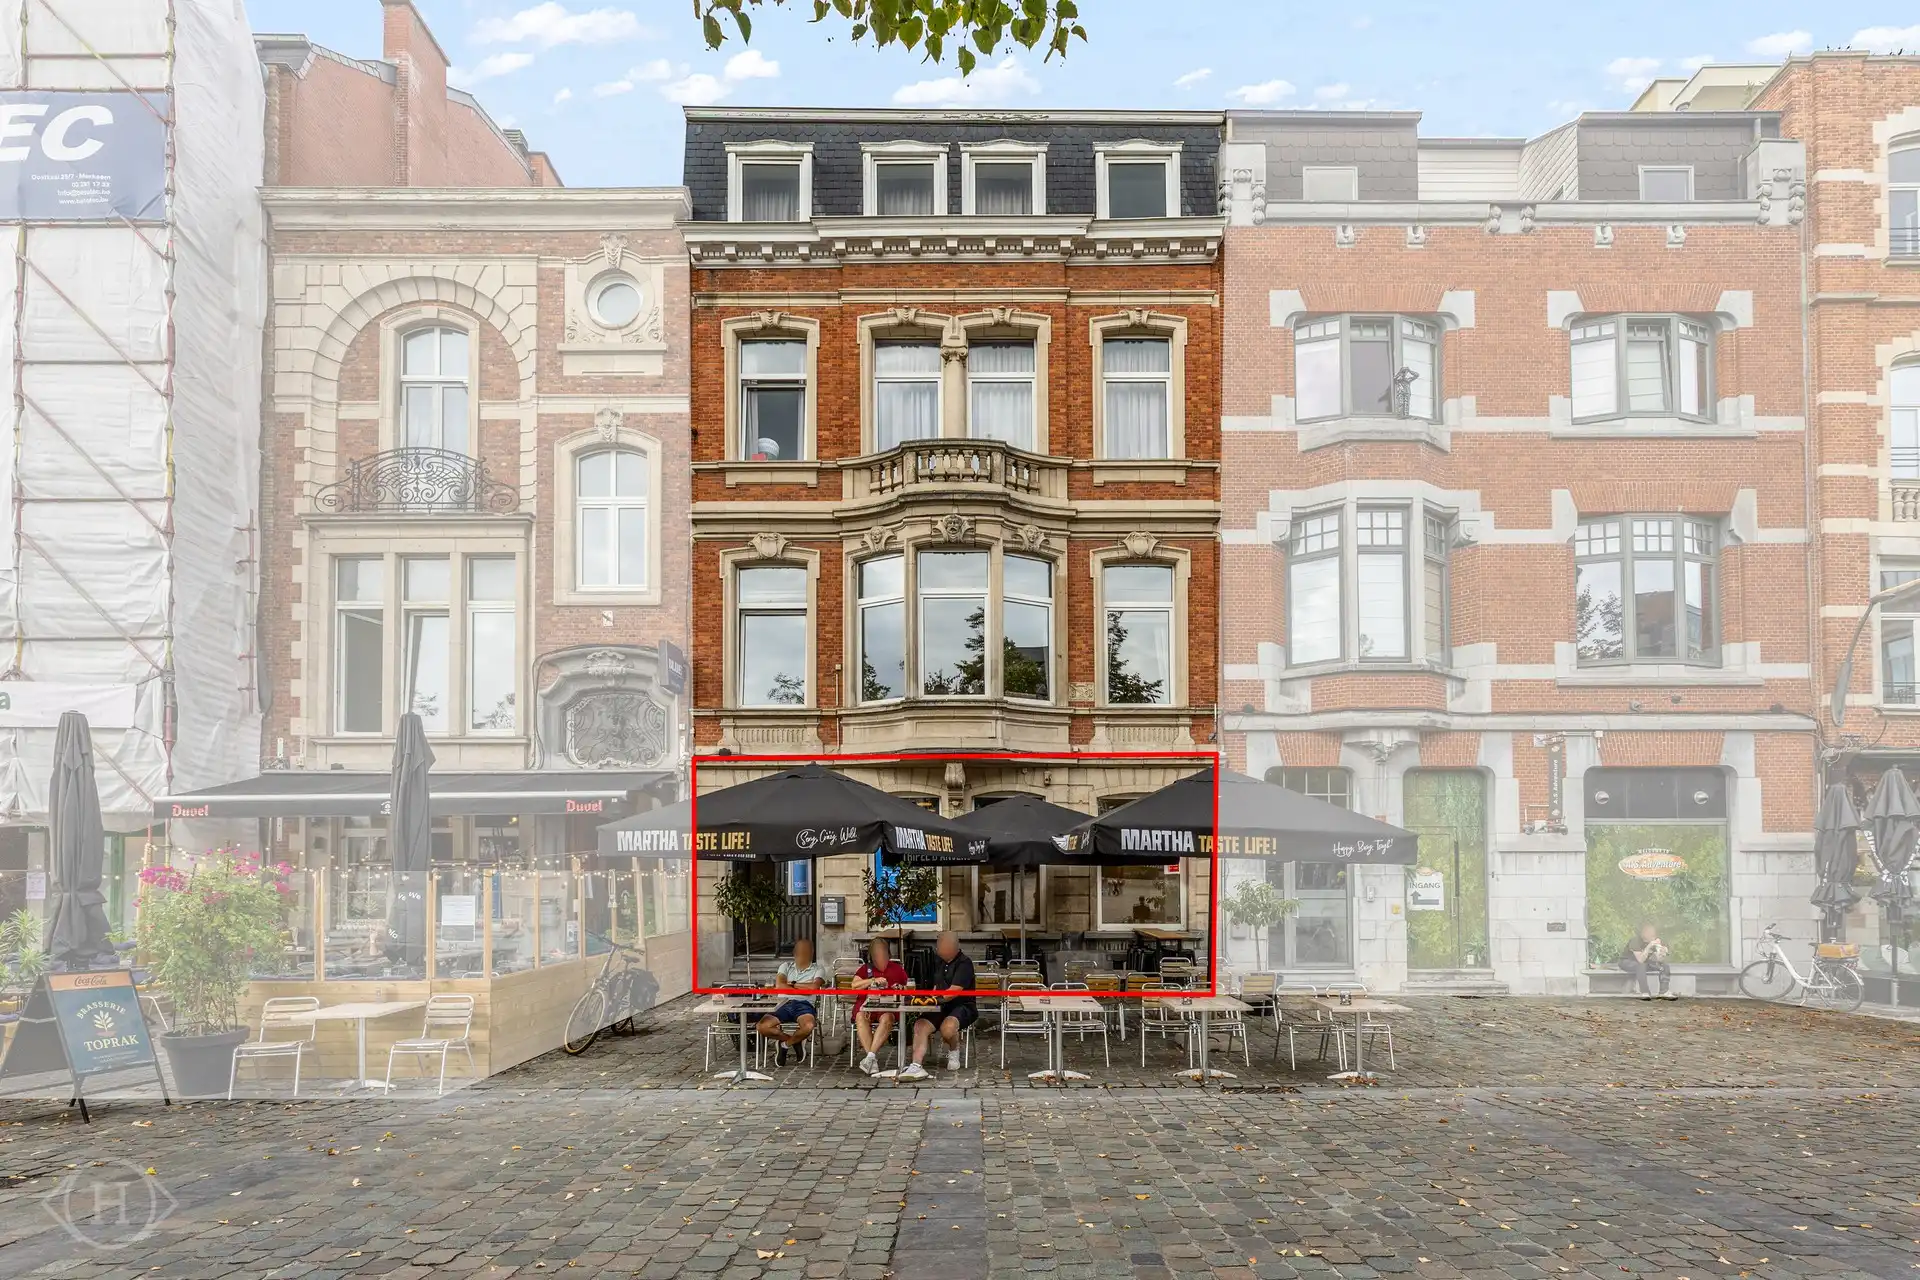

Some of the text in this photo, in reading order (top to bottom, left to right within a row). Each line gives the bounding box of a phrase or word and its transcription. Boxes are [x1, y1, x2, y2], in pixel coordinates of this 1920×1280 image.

[172, 803, 209, 817] Duvel
[566, 799, 603, 813] Duvel
[616, 830, 679, 851] MARTHA
[721, 832, 751, 850] LIFE!
[894, 826, 927, 850] MARTHA
[1120, 828, 1195, 852] MARTHA
[1244, 836, 1277, 855] LIFE!
[76, 1000, 127, 1020] BRASSERIE
[83, 1034, 140, 1052] TOPRAK
